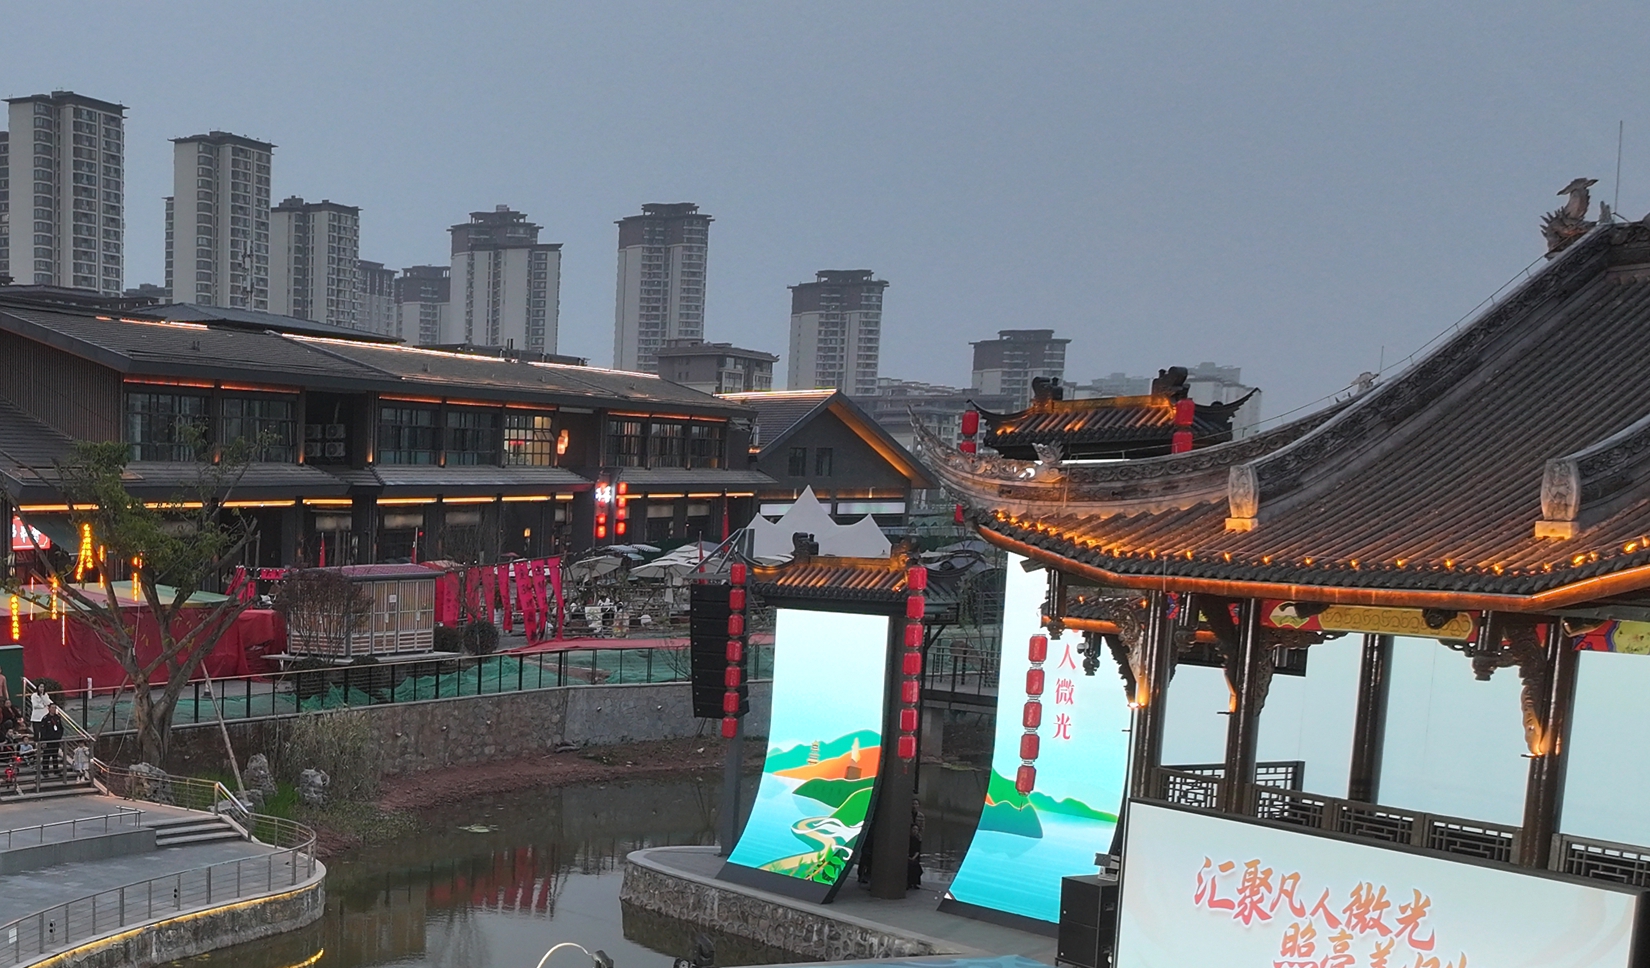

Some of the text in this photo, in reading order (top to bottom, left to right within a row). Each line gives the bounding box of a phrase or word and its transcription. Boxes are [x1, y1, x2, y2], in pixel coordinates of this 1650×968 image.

[1193, 855, 1436, 951] 汇聚凡人微光
